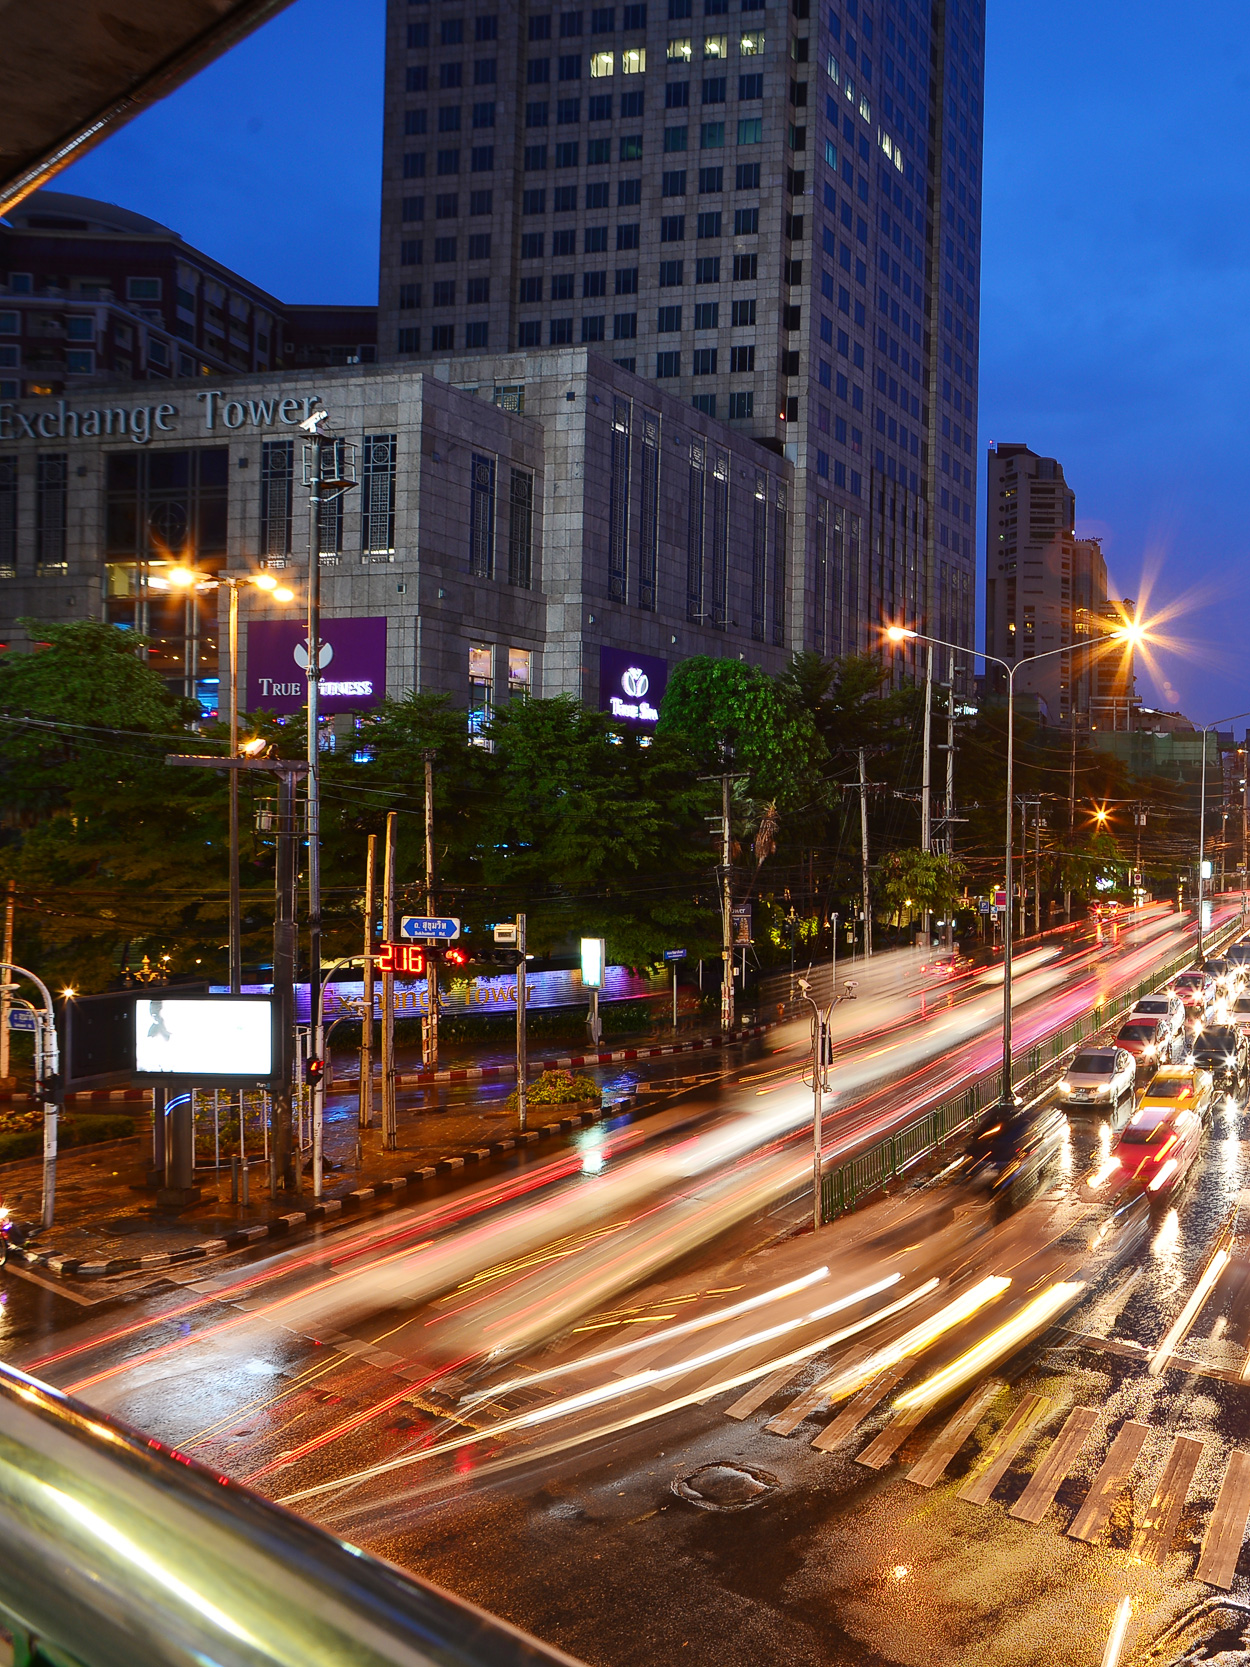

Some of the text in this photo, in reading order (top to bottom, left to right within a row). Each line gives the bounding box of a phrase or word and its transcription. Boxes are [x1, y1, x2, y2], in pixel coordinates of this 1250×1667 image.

[0, 390, 322, 444] Exchange Tower
[258, 678, 373, 696] TRUE ITNESS
